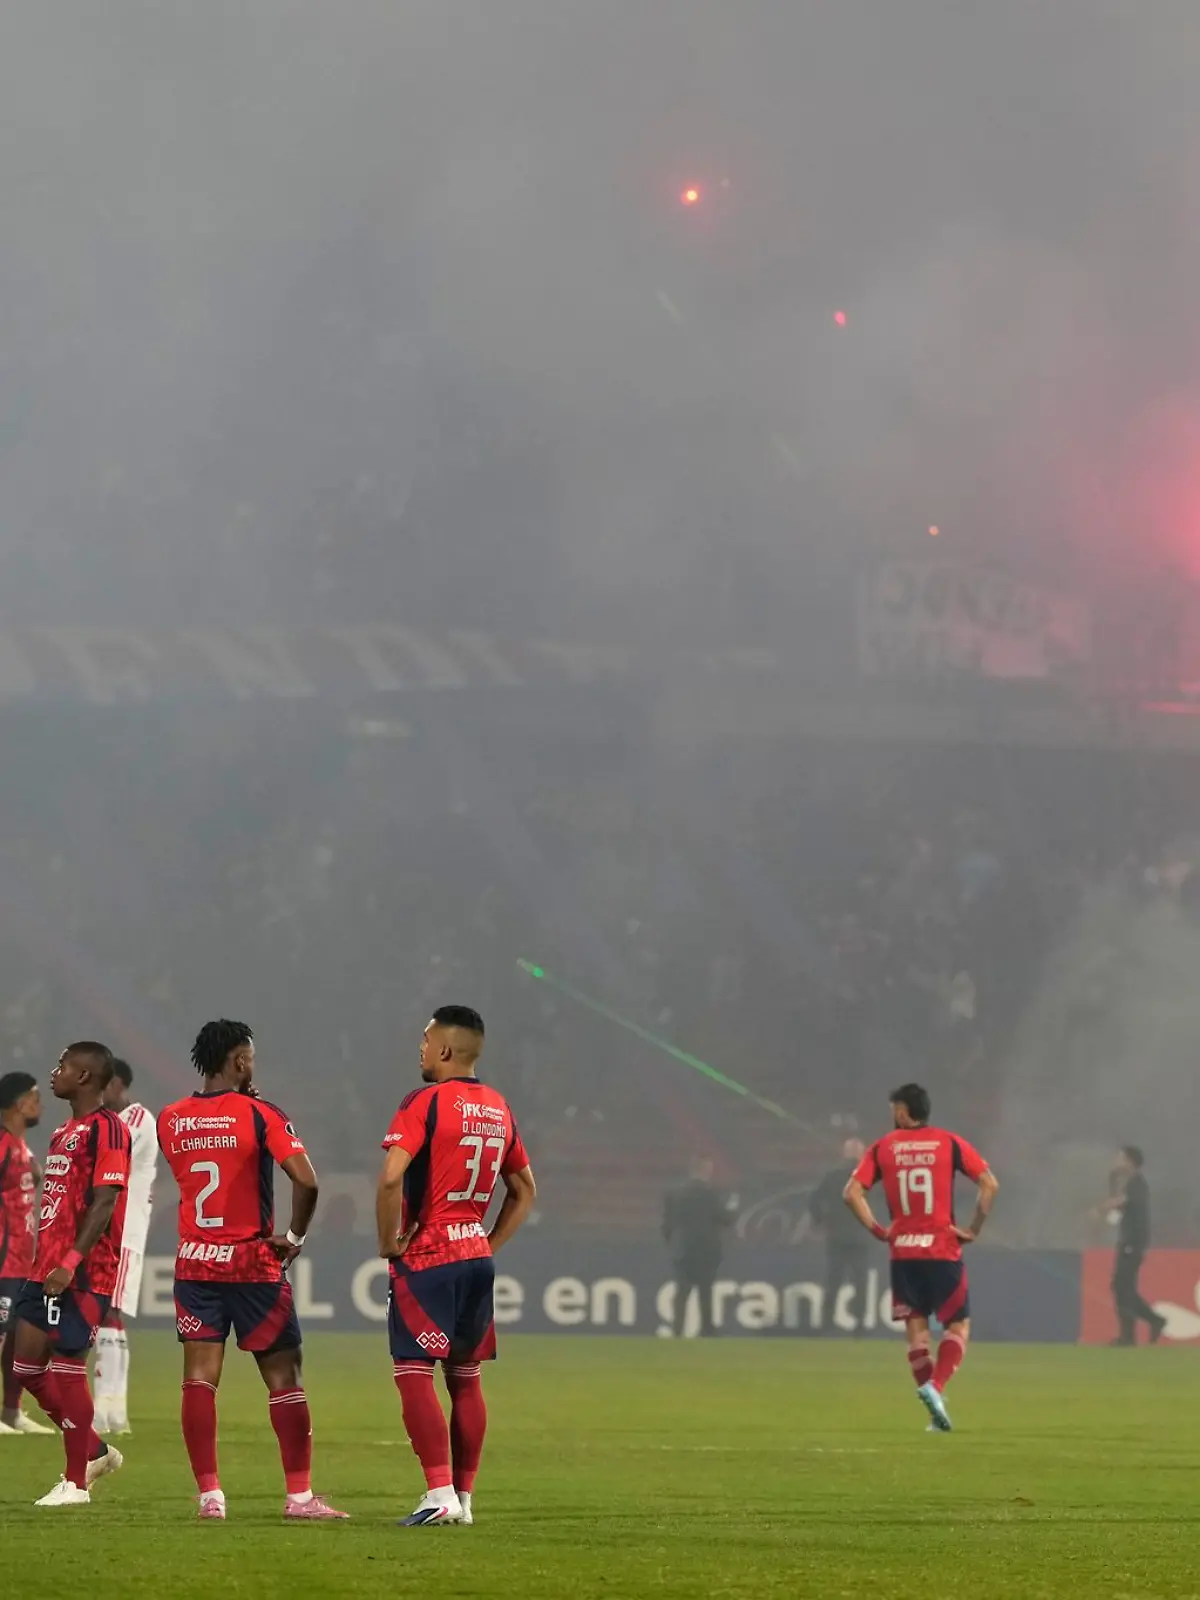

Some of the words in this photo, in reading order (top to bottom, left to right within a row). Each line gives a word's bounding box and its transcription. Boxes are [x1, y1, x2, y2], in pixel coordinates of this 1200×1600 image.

[174, 1116, 198, 1136] JFK
[463, 1103, 483, 1119] JFK
[447, 1136, 505, 1202] 33
[896, 1167, 933, 1216] 19
[190, 1161, 224, 1228] 2
[178, 1242, 235, 1262] MAPEI
[543, 1279, 637, 1325] en
